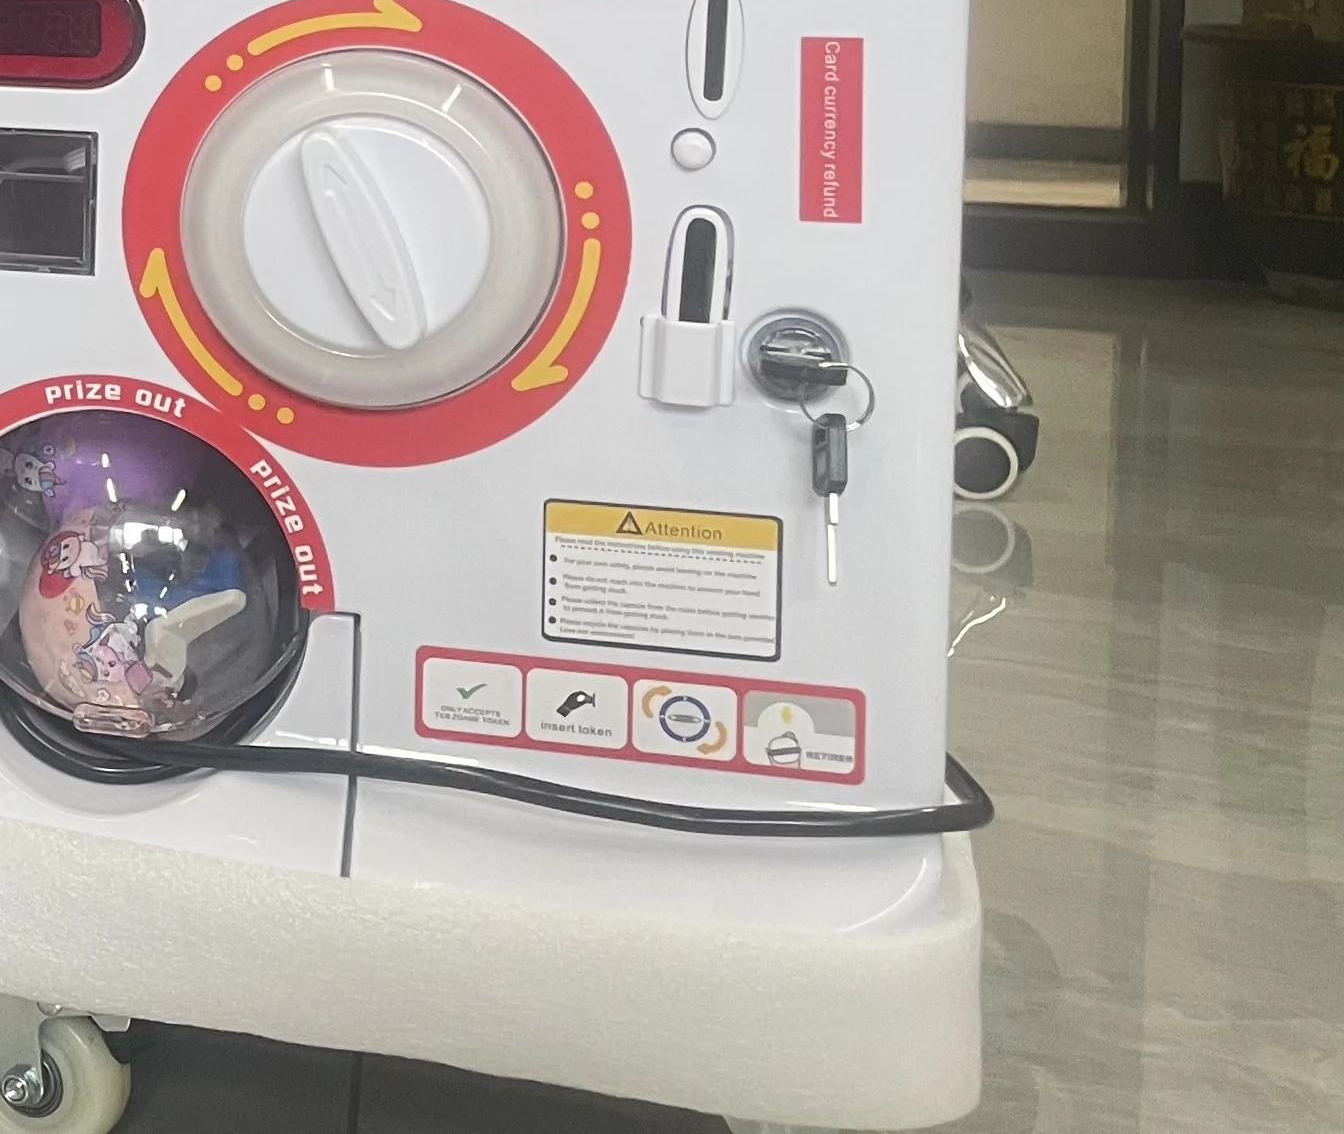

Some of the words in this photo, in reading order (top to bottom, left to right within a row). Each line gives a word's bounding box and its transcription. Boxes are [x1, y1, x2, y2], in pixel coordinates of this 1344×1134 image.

[824, 41, 841, 81] Card
[819, 85, 837, 160] currency
[823, 163, 840, 218] refund
[44, 379, 121, 405] prize
[135, 388, 186, 418] out
[249, 459, 304, 534] prize
[294, 545, 323, 595] out
[644, 521, 723, 540] Attention
[540, 721, 575, 735] insert
[577, 723, 612, 738] token
